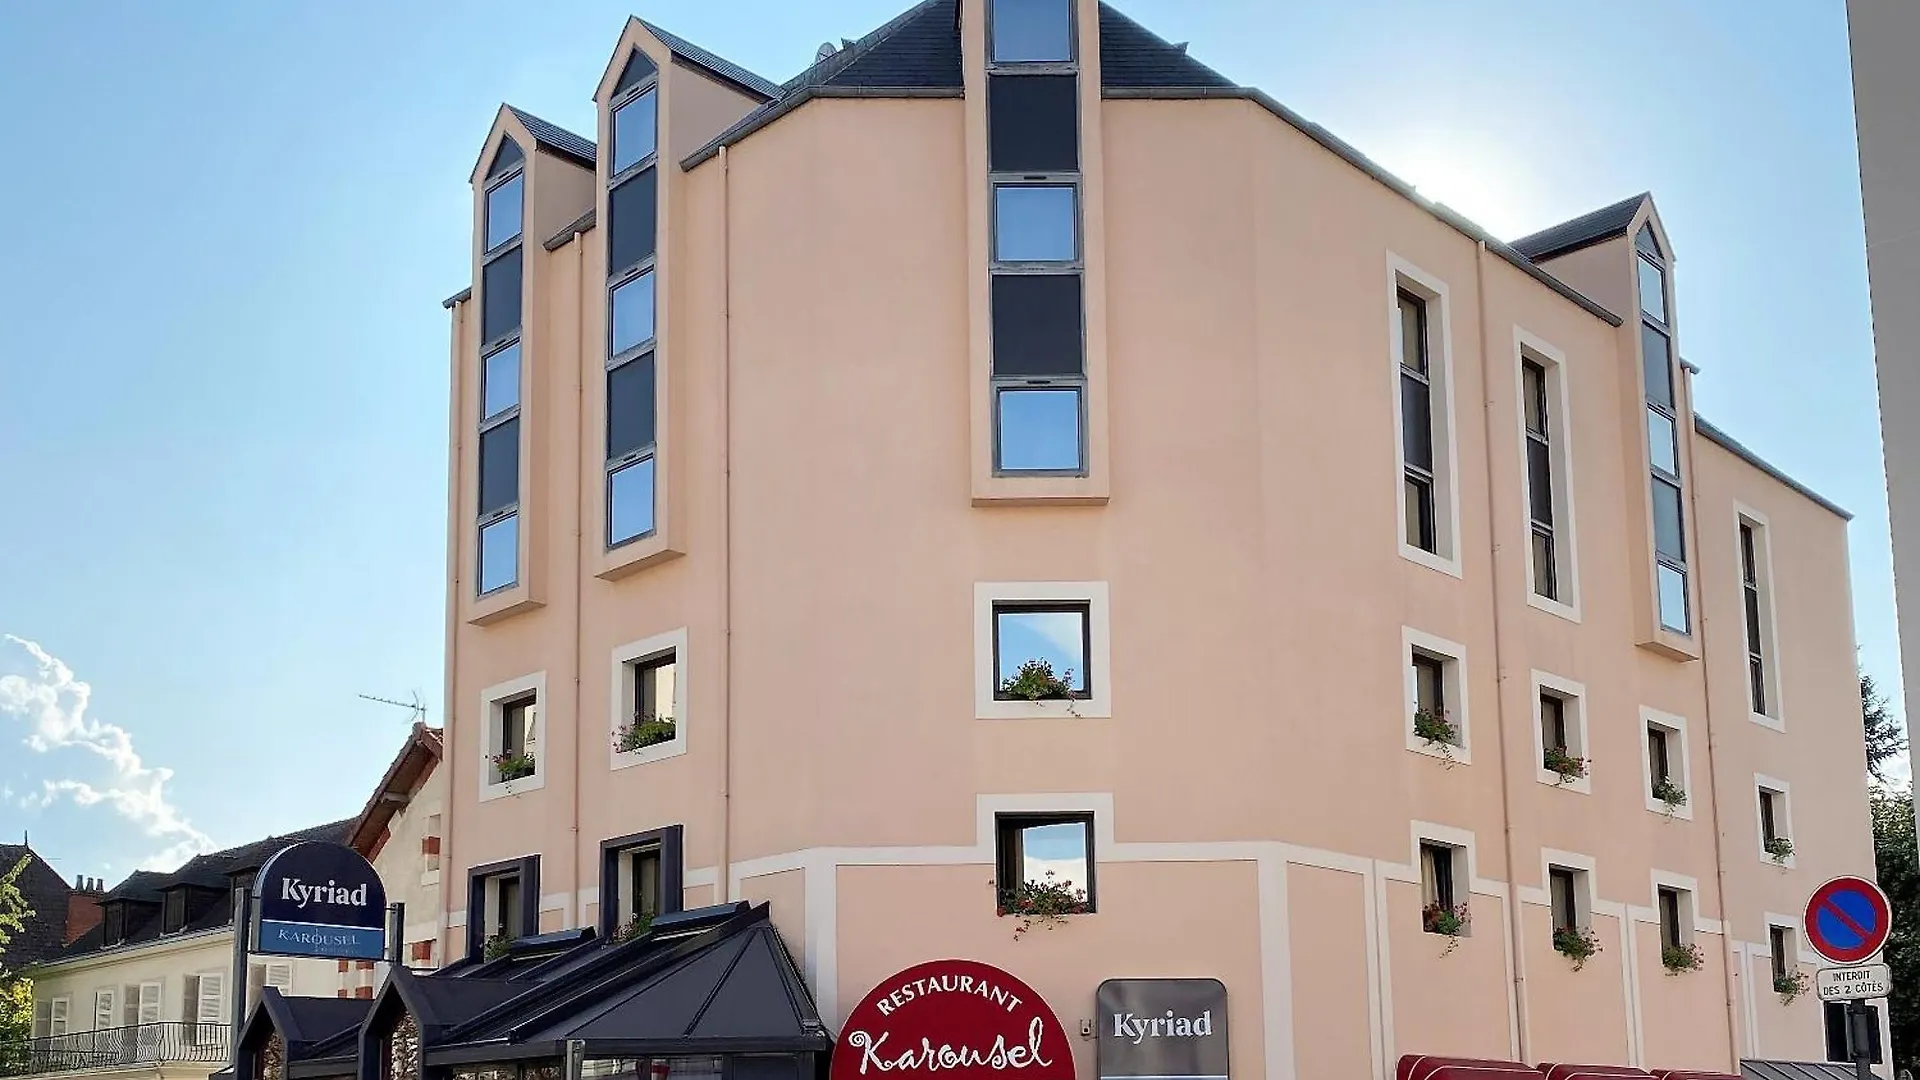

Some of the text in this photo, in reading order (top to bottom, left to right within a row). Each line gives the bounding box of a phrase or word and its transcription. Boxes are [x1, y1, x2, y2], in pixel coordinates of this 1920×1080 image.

[281, 876, 368, 909] Kyriad
[1823, 986, 1840, 996] DES
[1844, 985, 1852, 995] 2
[1833, 970, 1871, 982] INTERDIT
[876, 974, 1023, 1017] RESTAURANT
[1112, 1009, 1213, 1046] Kyriad
[847, 1015, 1053, 1076] Karousel
